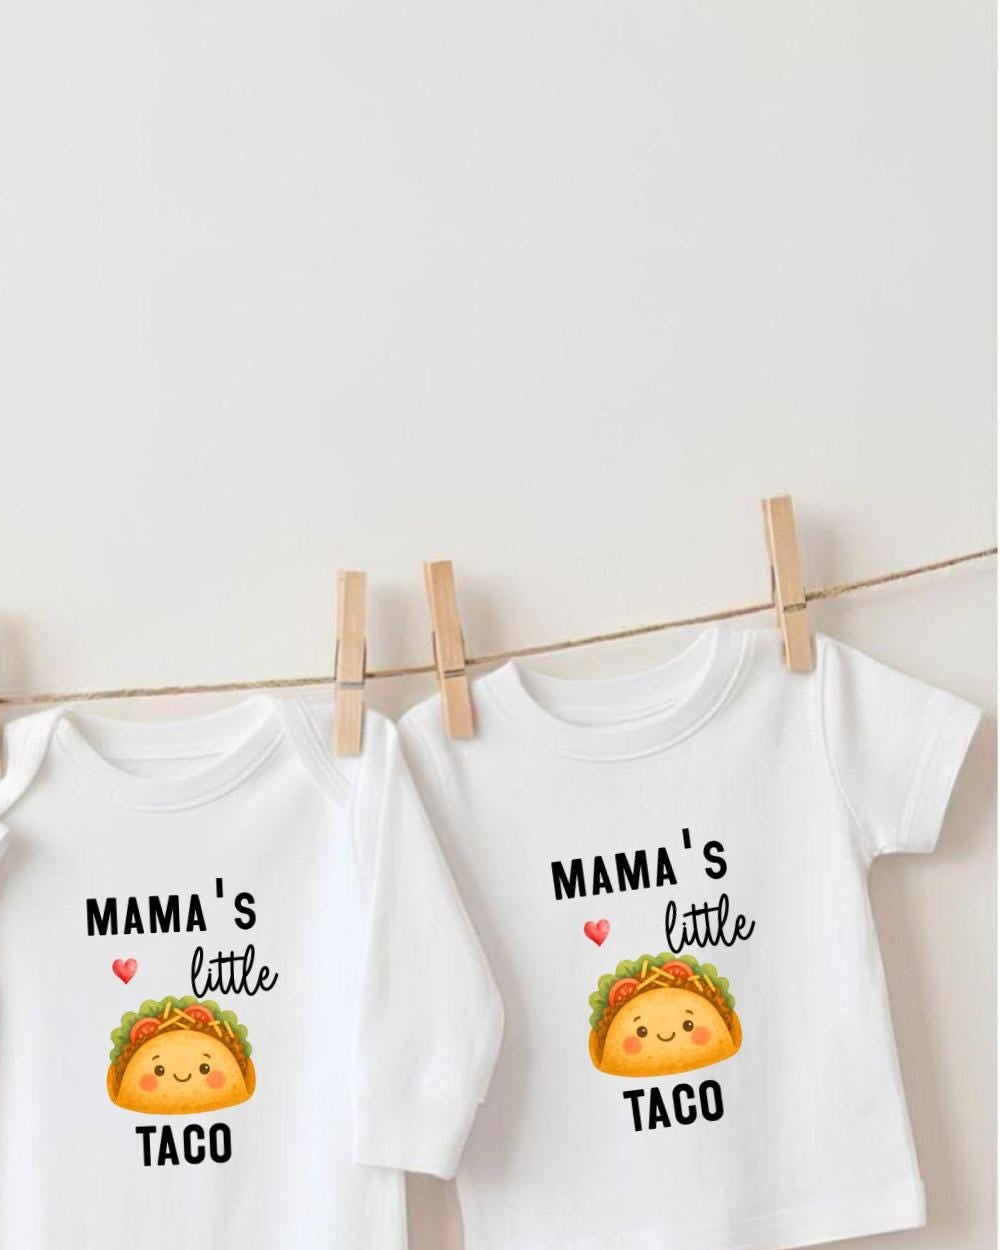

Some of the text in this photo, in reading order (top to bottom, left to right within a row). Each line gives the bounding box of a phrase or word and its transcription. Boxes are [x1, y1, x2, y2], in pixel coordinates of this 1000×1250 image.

[551, 827, 728, 901] MAMA'S
[86, 877, 257, 937] MAMA'S
[664, 893, 756, 955] little
[190, 943, 279, 999] little
[623, 1079, 725, 1132] TACO
[135, 1122, 232, 1167] TACO
